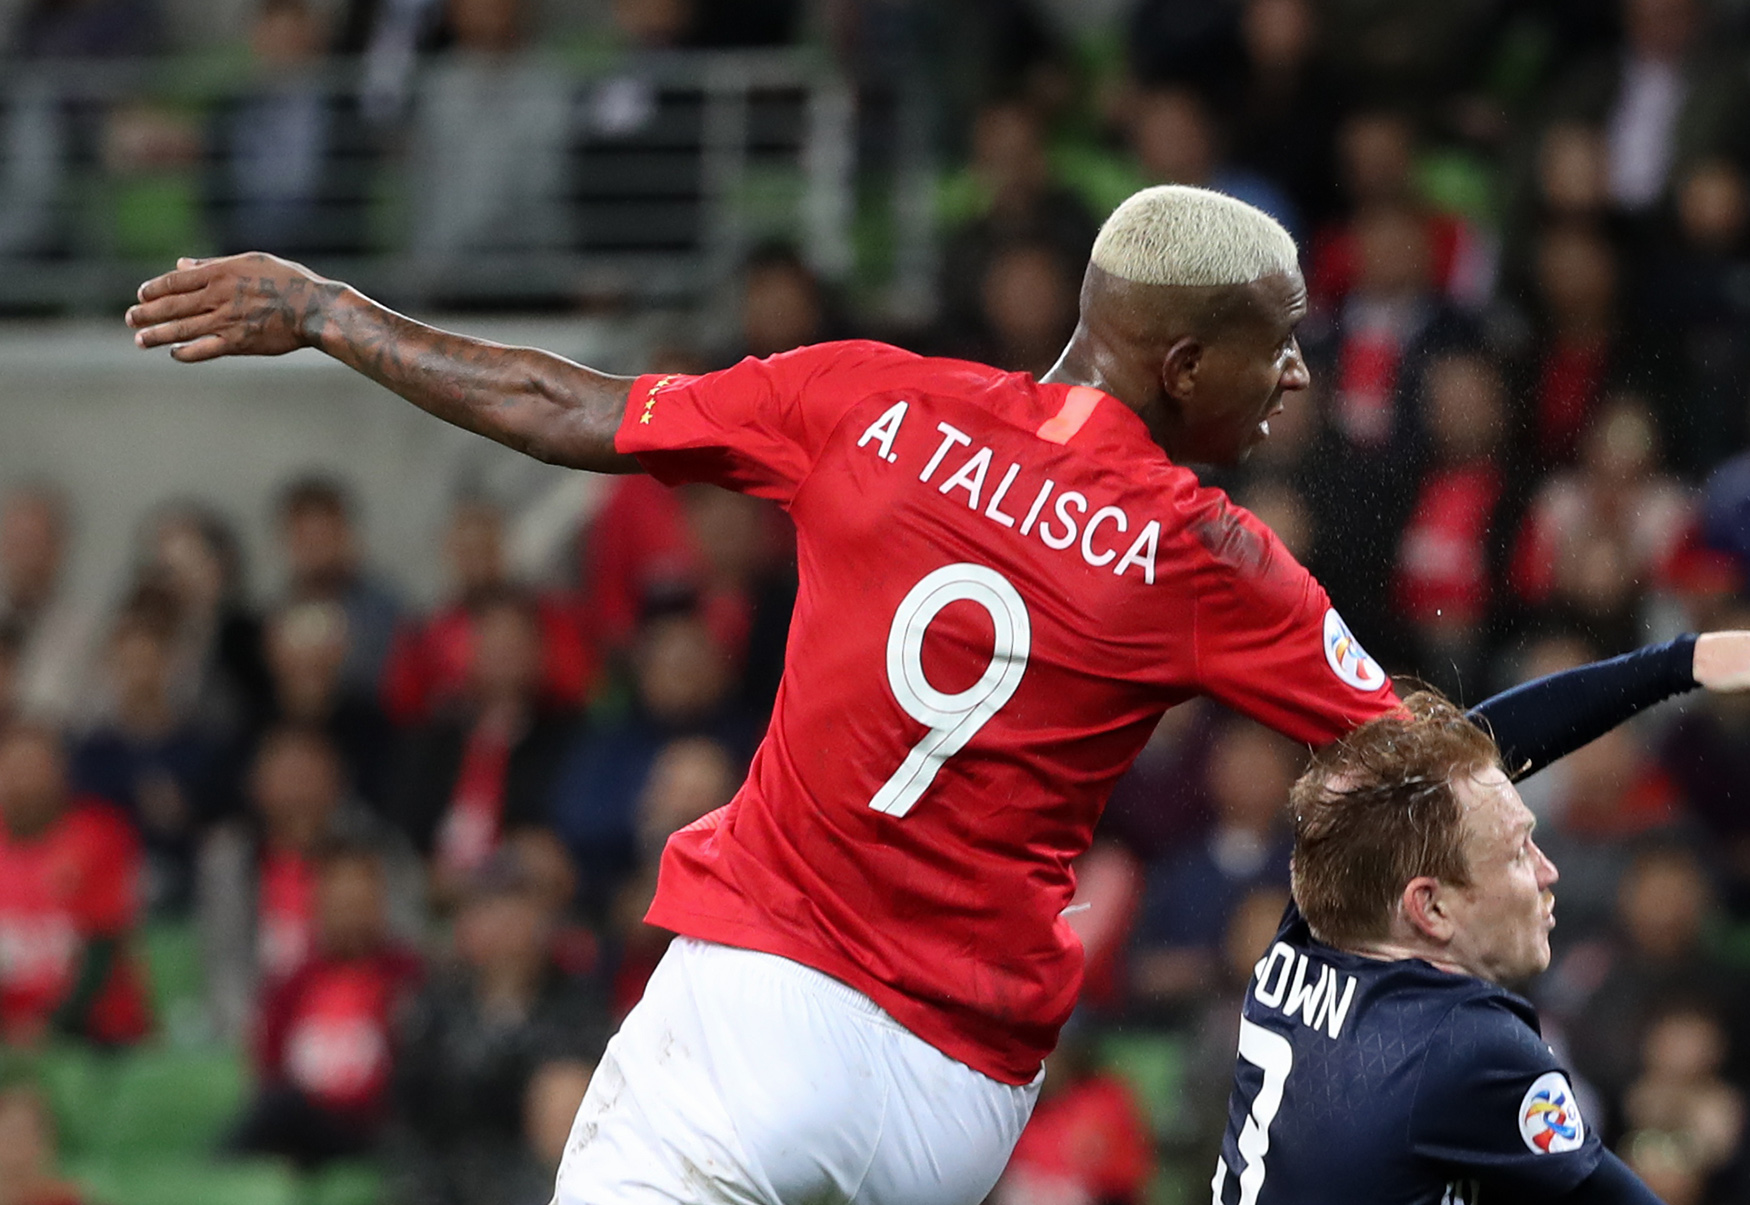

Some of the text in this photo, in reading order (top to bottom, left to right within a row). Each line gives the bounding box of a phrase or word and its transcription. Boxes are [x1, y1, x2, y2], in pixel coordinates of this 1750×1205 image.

[857, 400, 1162, 585] A. TALISCA
[868, 562, 1031, 818] 9
[1254, 941, 1358, 1040] OWN
